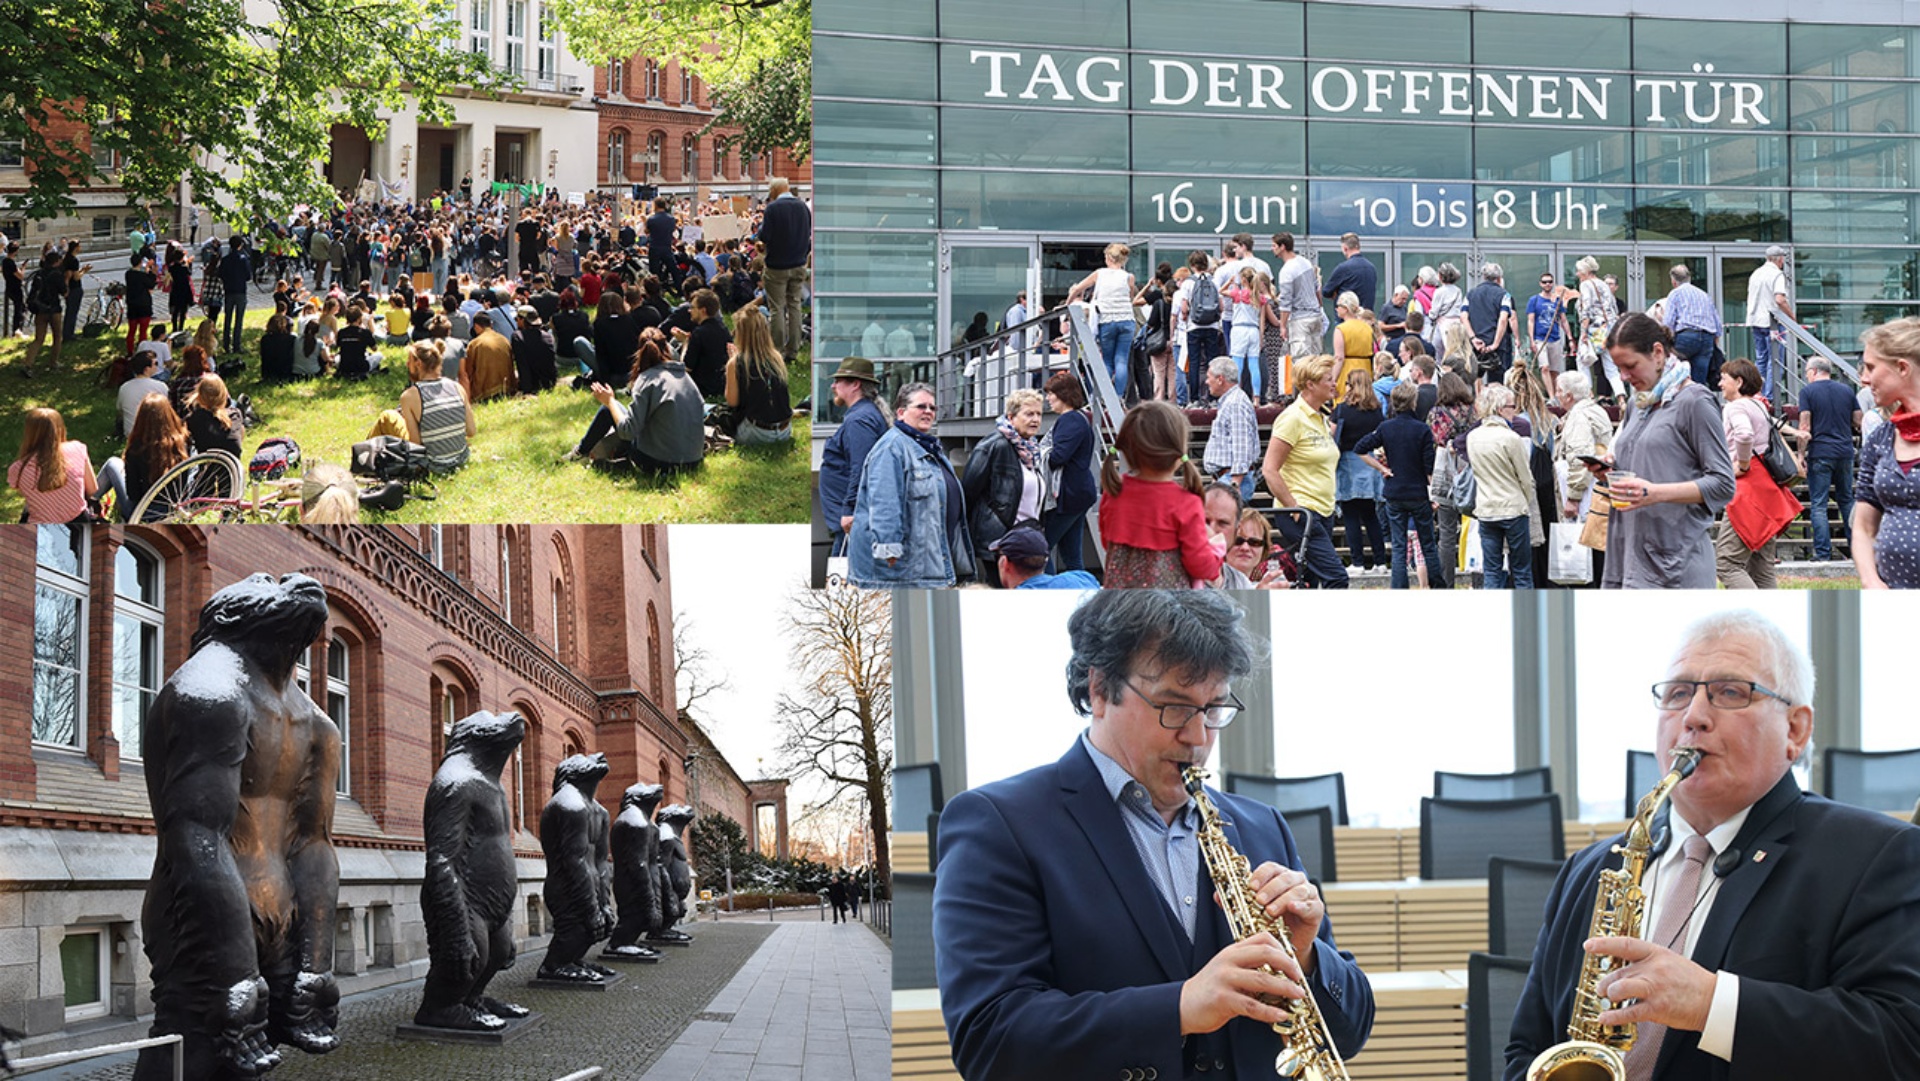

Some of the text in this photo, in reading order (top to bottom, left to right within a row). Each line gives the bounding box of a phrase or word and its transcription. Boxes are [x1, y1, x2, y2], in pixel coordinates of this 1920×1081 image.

[970, 50, 1770, 124] TAG DER OFFENEN TÜR
[1151, 182, 1607, 234] 16. Juni 10 bis 18 Uhr
